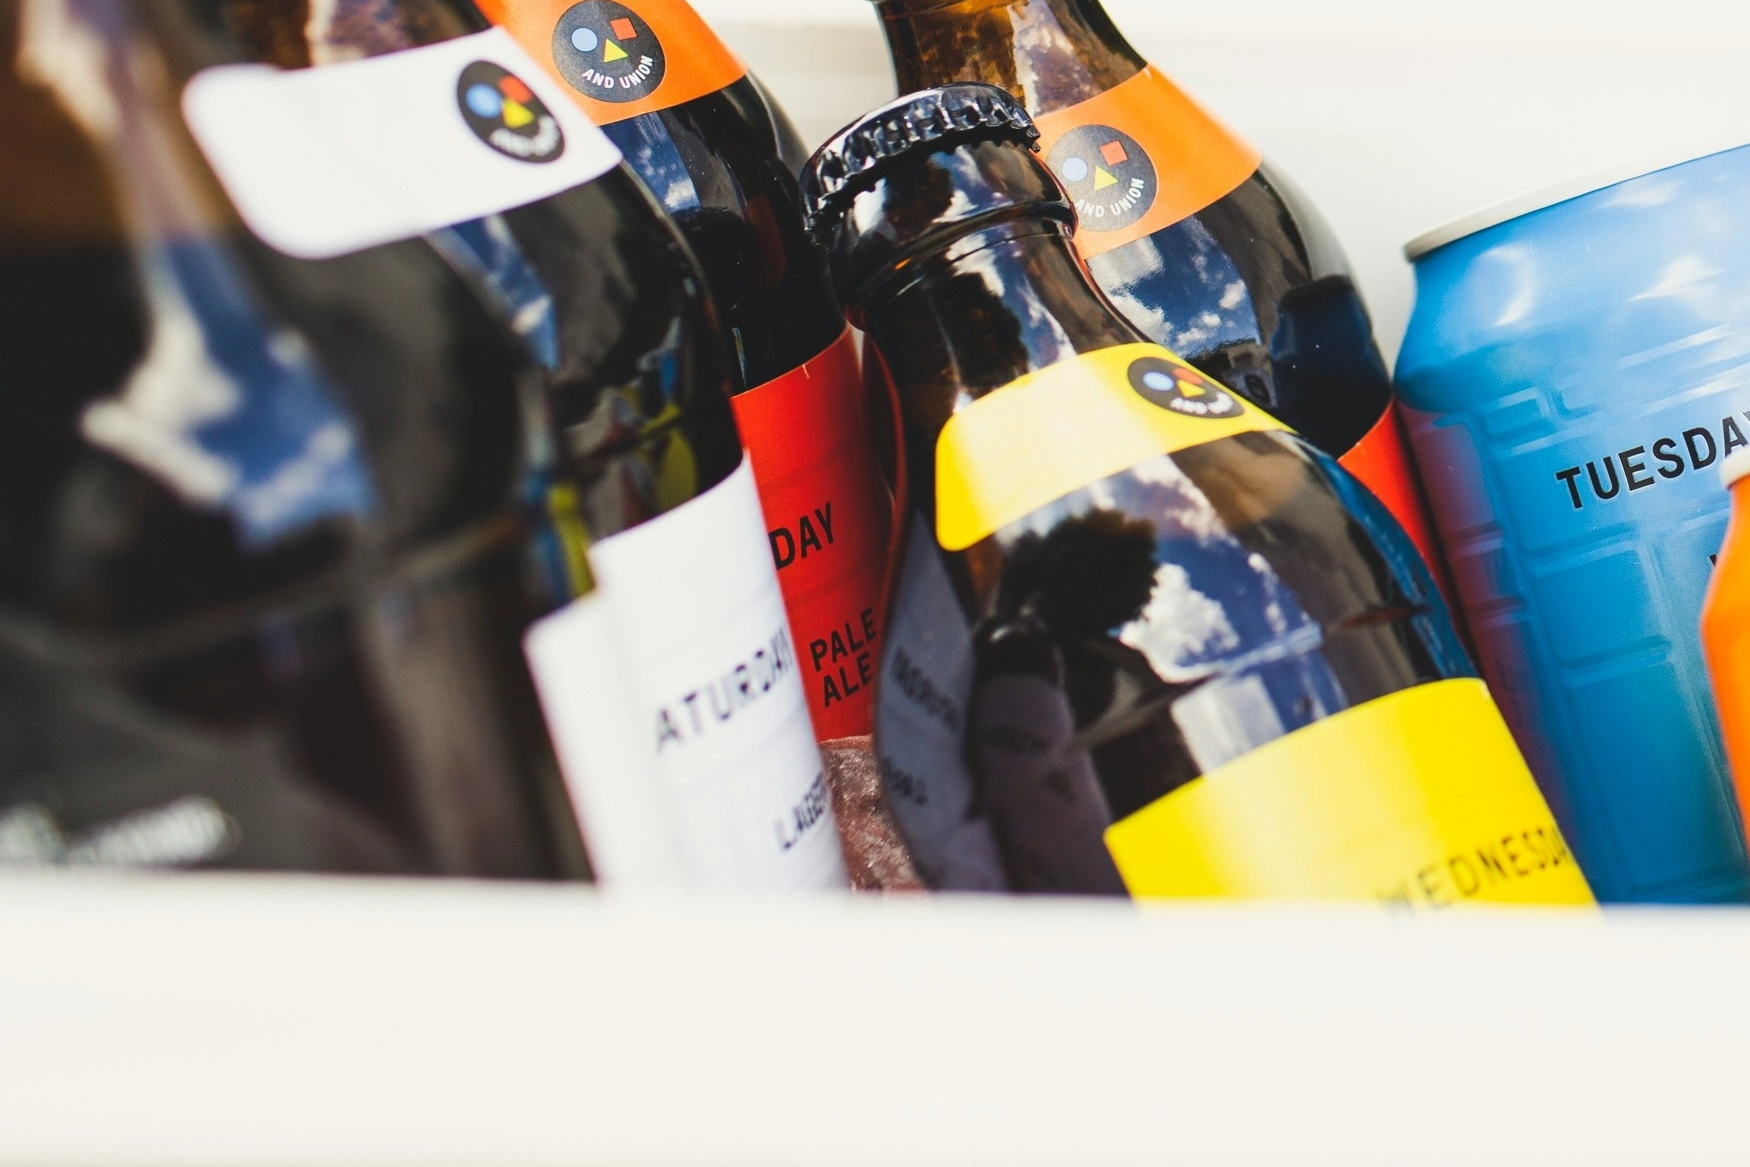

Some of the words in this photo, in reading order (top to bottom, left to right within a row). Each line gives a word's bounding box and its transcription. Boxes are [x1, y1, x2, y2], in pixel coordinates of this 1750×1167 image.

[581, 68, 615, 89] AND
[619, 55, 654, 89] UNION
[1075, 198, 1105, 218] AND
[1110, 177, 1145, 217] UNION
[809, 608, 877, 672] PALE
[823, 651, 874, 708] ALE
